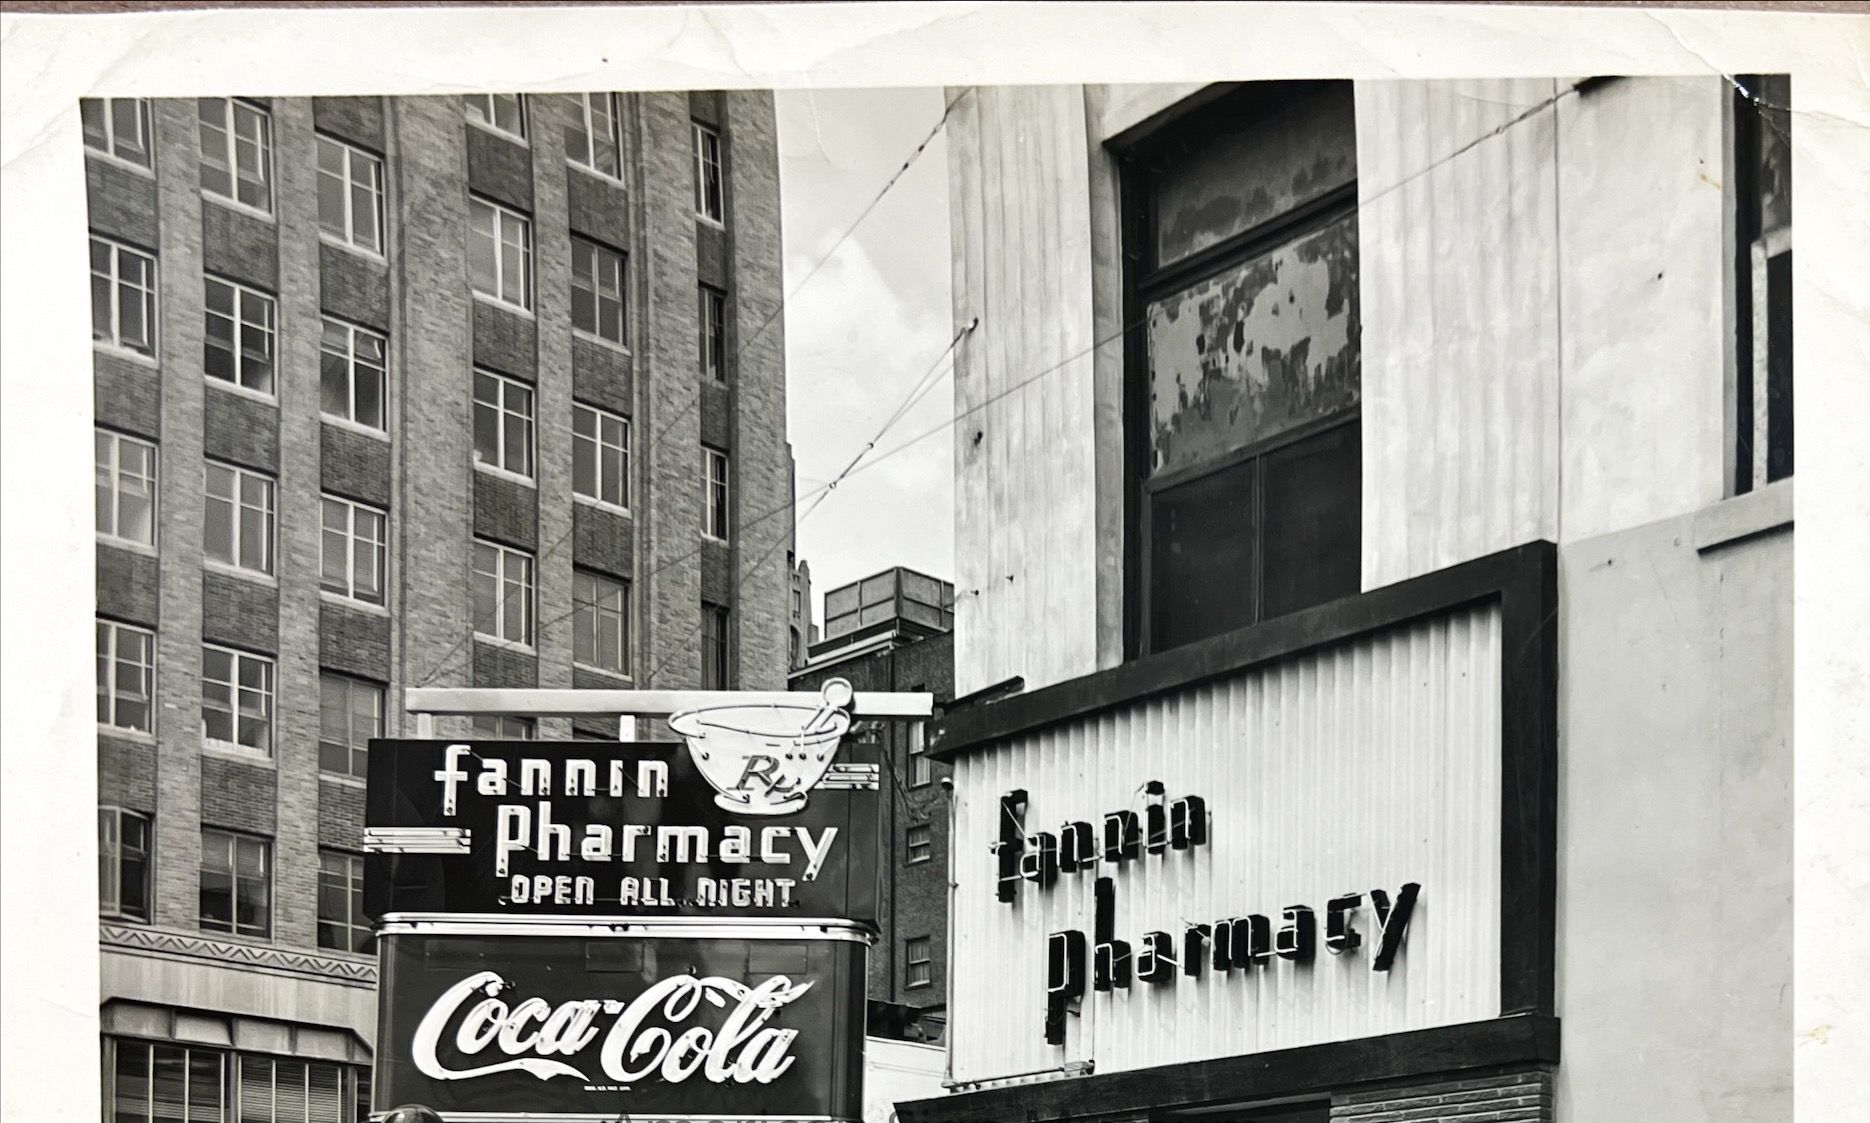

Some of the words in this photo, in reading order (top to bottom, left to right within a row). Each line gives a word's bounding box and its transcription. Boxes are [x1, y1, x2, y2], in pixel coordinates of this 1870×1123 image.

[435, 744, 669, 816] fannin
[496, 801, 838, 881] pharmacy
[989, 780, 1207, 903] fannin
[510, 874, 595, 905] OPEN
[620, 877, 676, 906] ALL
[697, 877, 797, 907] NIGHT
[1044, 876, 1422, 1044] pharmacy
[412, 970, 815, 1084] Coca-Cola
